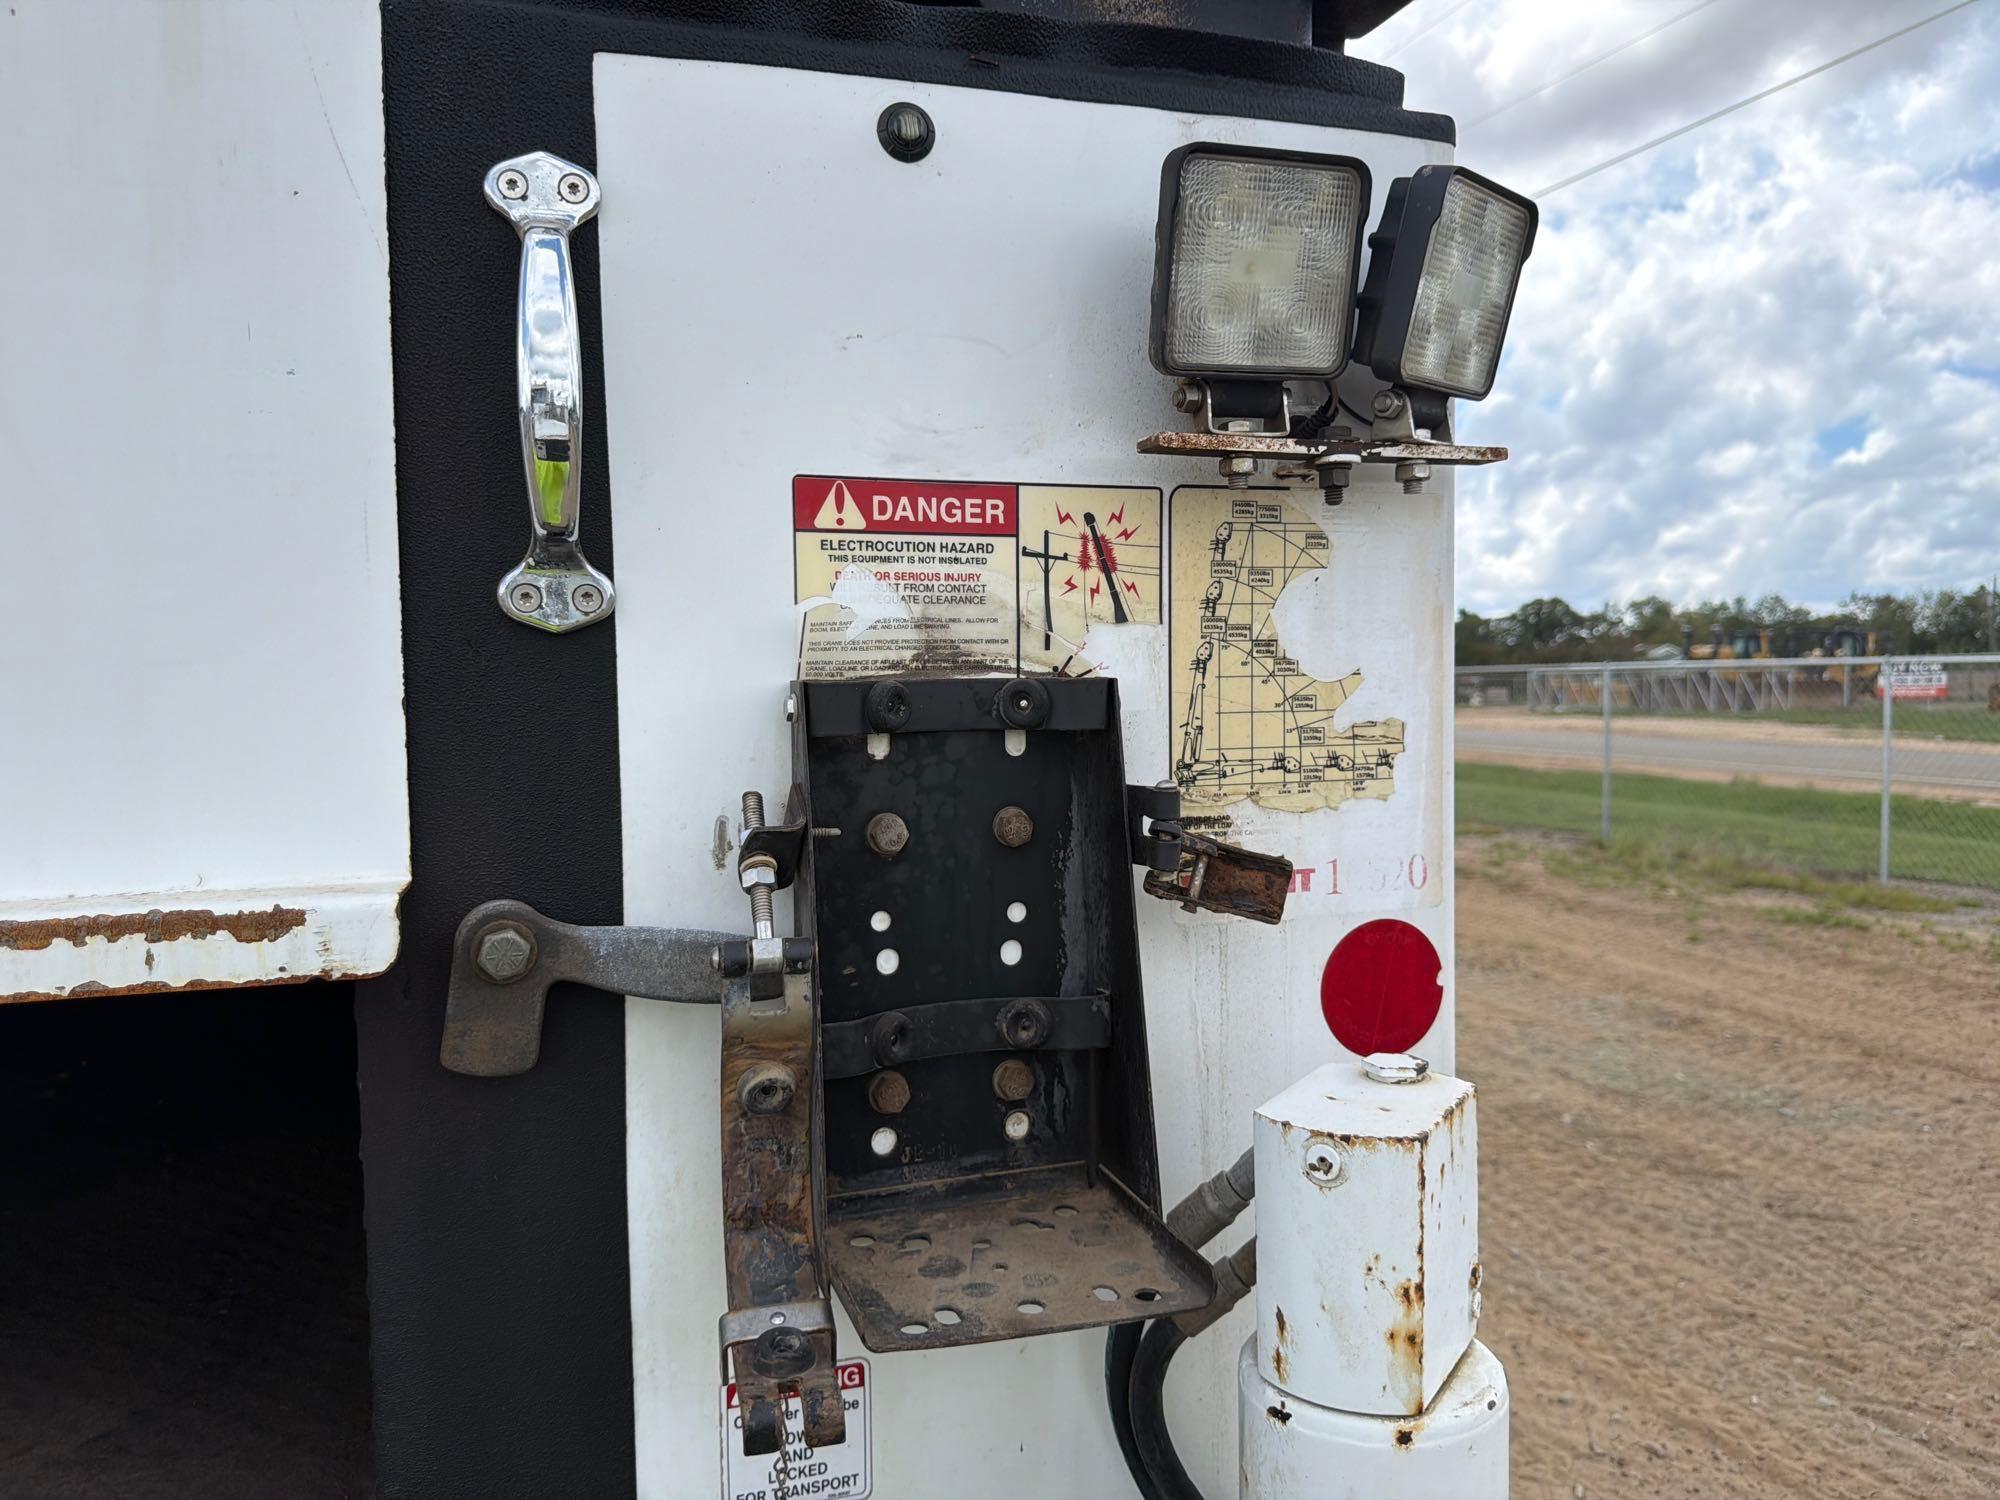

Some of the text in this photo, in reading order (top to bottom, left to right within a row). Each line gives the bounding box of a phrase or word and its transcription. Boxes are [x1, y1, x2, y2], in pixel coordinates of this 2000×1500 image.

[872, 494, 1006, 525] DANGER
[820, 539, 995, 554] ELECTROCUTION HAZARD
[828, 554, 988, 565] THIS EQUIPMENT IS NOT INSULATED
[875, 571, 891, 581] OR
[893, 571, 941, 582] SERIOUS
[944, 572, 982, 583] INJURY
[903, 583, 935, 593] FROM
[937, 584, 987, 594] CONTACT
[925, 595, 987, 605] CLEARANCE
[843, 1398, 860, 1411] be
[785, 1448, 814, 1463] AND
[768, 1462, 828, 1484] LCKED
